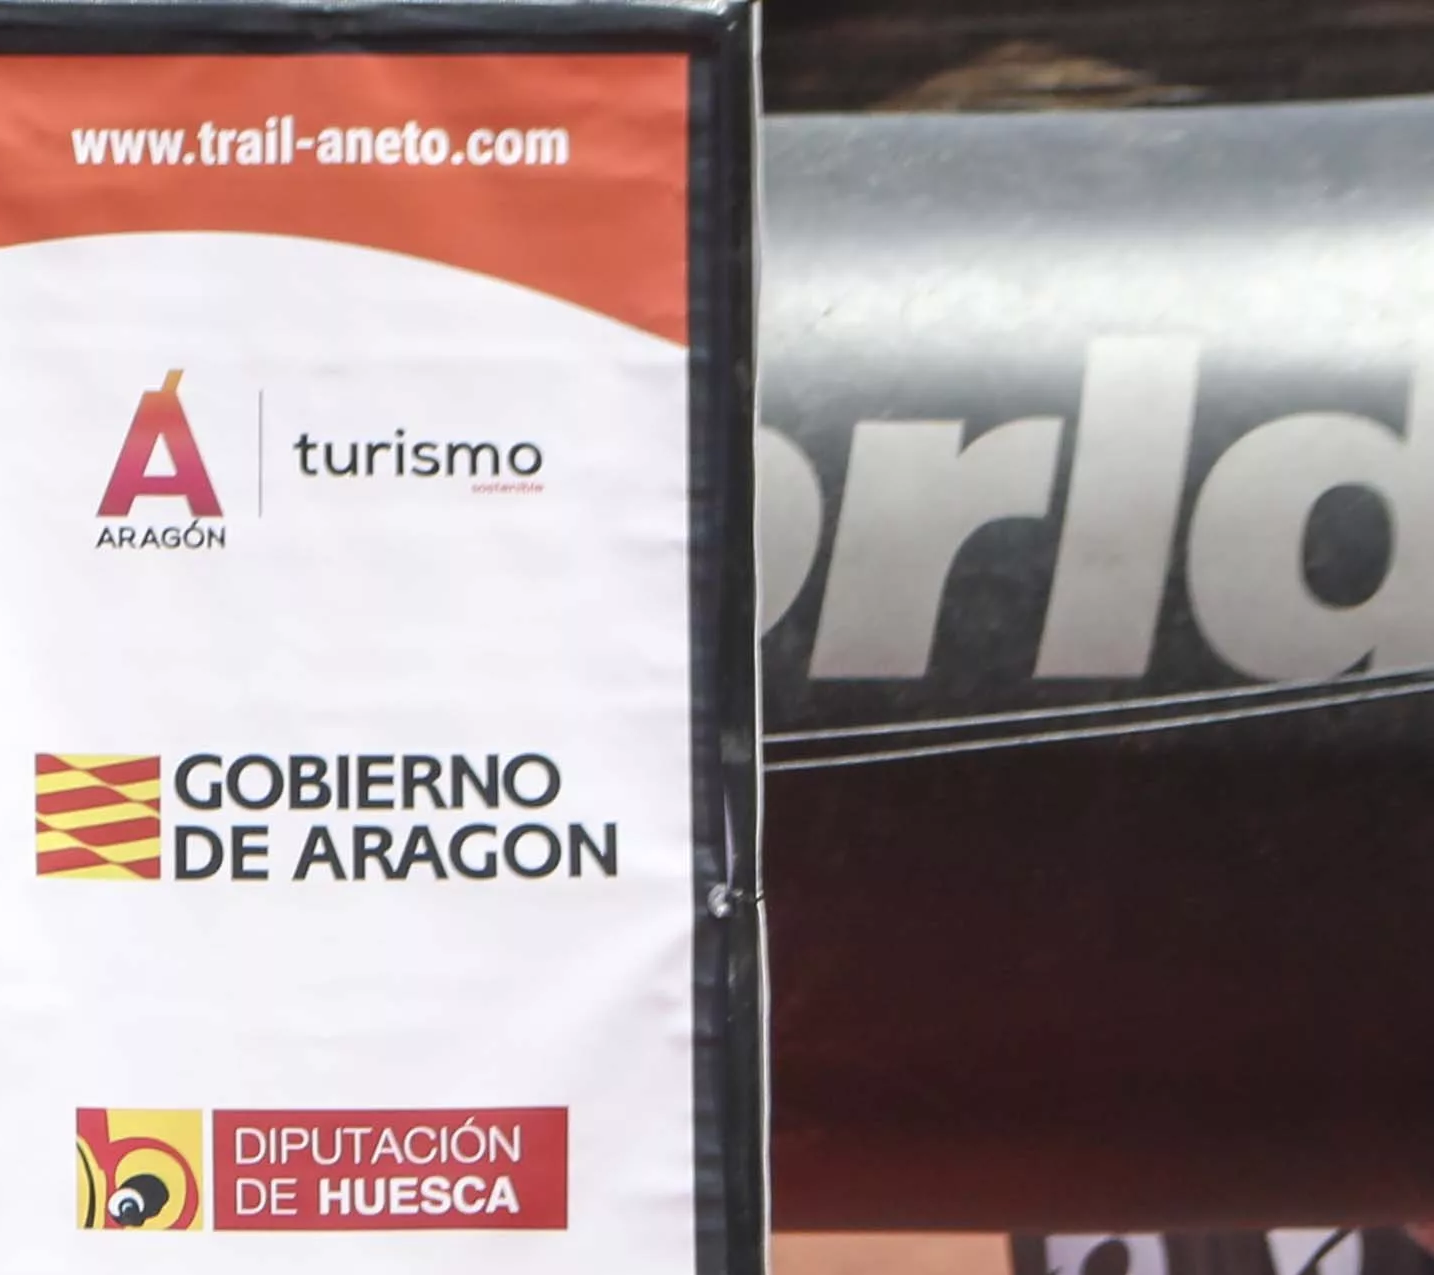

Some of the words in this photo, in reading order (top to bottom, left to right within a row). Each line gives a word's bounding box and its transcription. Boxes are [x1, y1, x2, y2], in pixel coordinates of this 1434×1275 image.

[71, 116, 570, 167] www.trail-aneto.com
[293, 428, 543, 478] turismo
[471, 482, 544, 494] sostenible
[95, 519, 226, 550] ARAGÓN
[174, 751, 562, 811] GOBIERNO
[173, 823, 270, 881] DE
[291, 821, 619, 881] ARAGON
[234, 1117, 521, 1167] DIPUTACIÓN
[234, 1178, 298, 1216] DE
[318, 1176, 521, 1216] HUESCA
